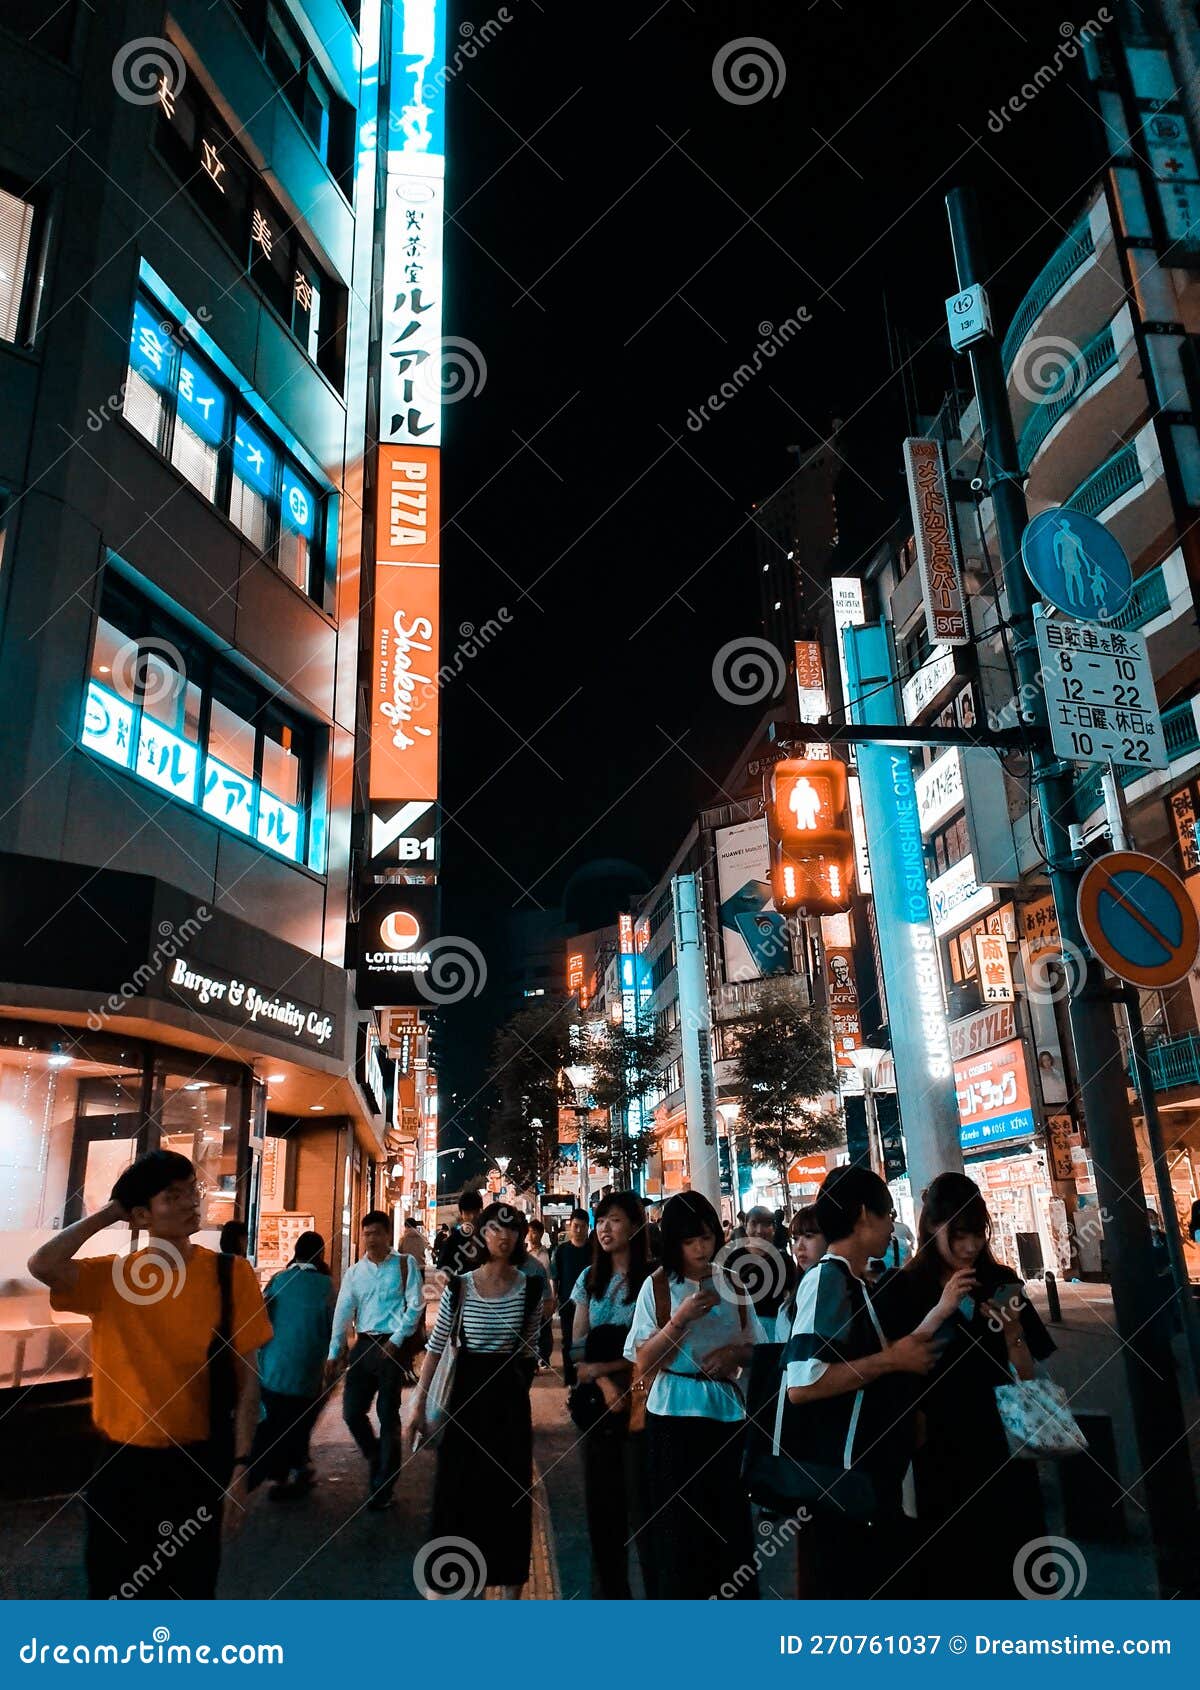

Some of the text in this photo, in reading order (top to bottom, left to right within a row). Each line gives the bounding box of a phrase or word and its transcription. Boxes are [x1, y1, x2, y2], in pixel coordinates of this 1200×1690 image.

[390, 461, 427, 547] PIZZA
[937, 616, 964, 634] 5F
[1046, 624, 1141, 656] 自転車を除く
[379, 610, 432, 750] Shakey's
[1060, 651, 1073, 673] 8
[1115, 658, 1137, 681] 10
[1062, 677, 1085, 701] 12
[1112, 684, 1142, 708] 22
[1071, 731, 1093, 755] 10
[1122, 738, 1151, 762] 22
[399, 838, 434, 861] B1
[890, 756, 928, 923] TO SUNSHINE CITY
[365, 952, 431, 964] LOTTERIA
[172, 959, 333, 1042] Burger & Speciality Cafe
[832, 995, 856, 1004] KFC
